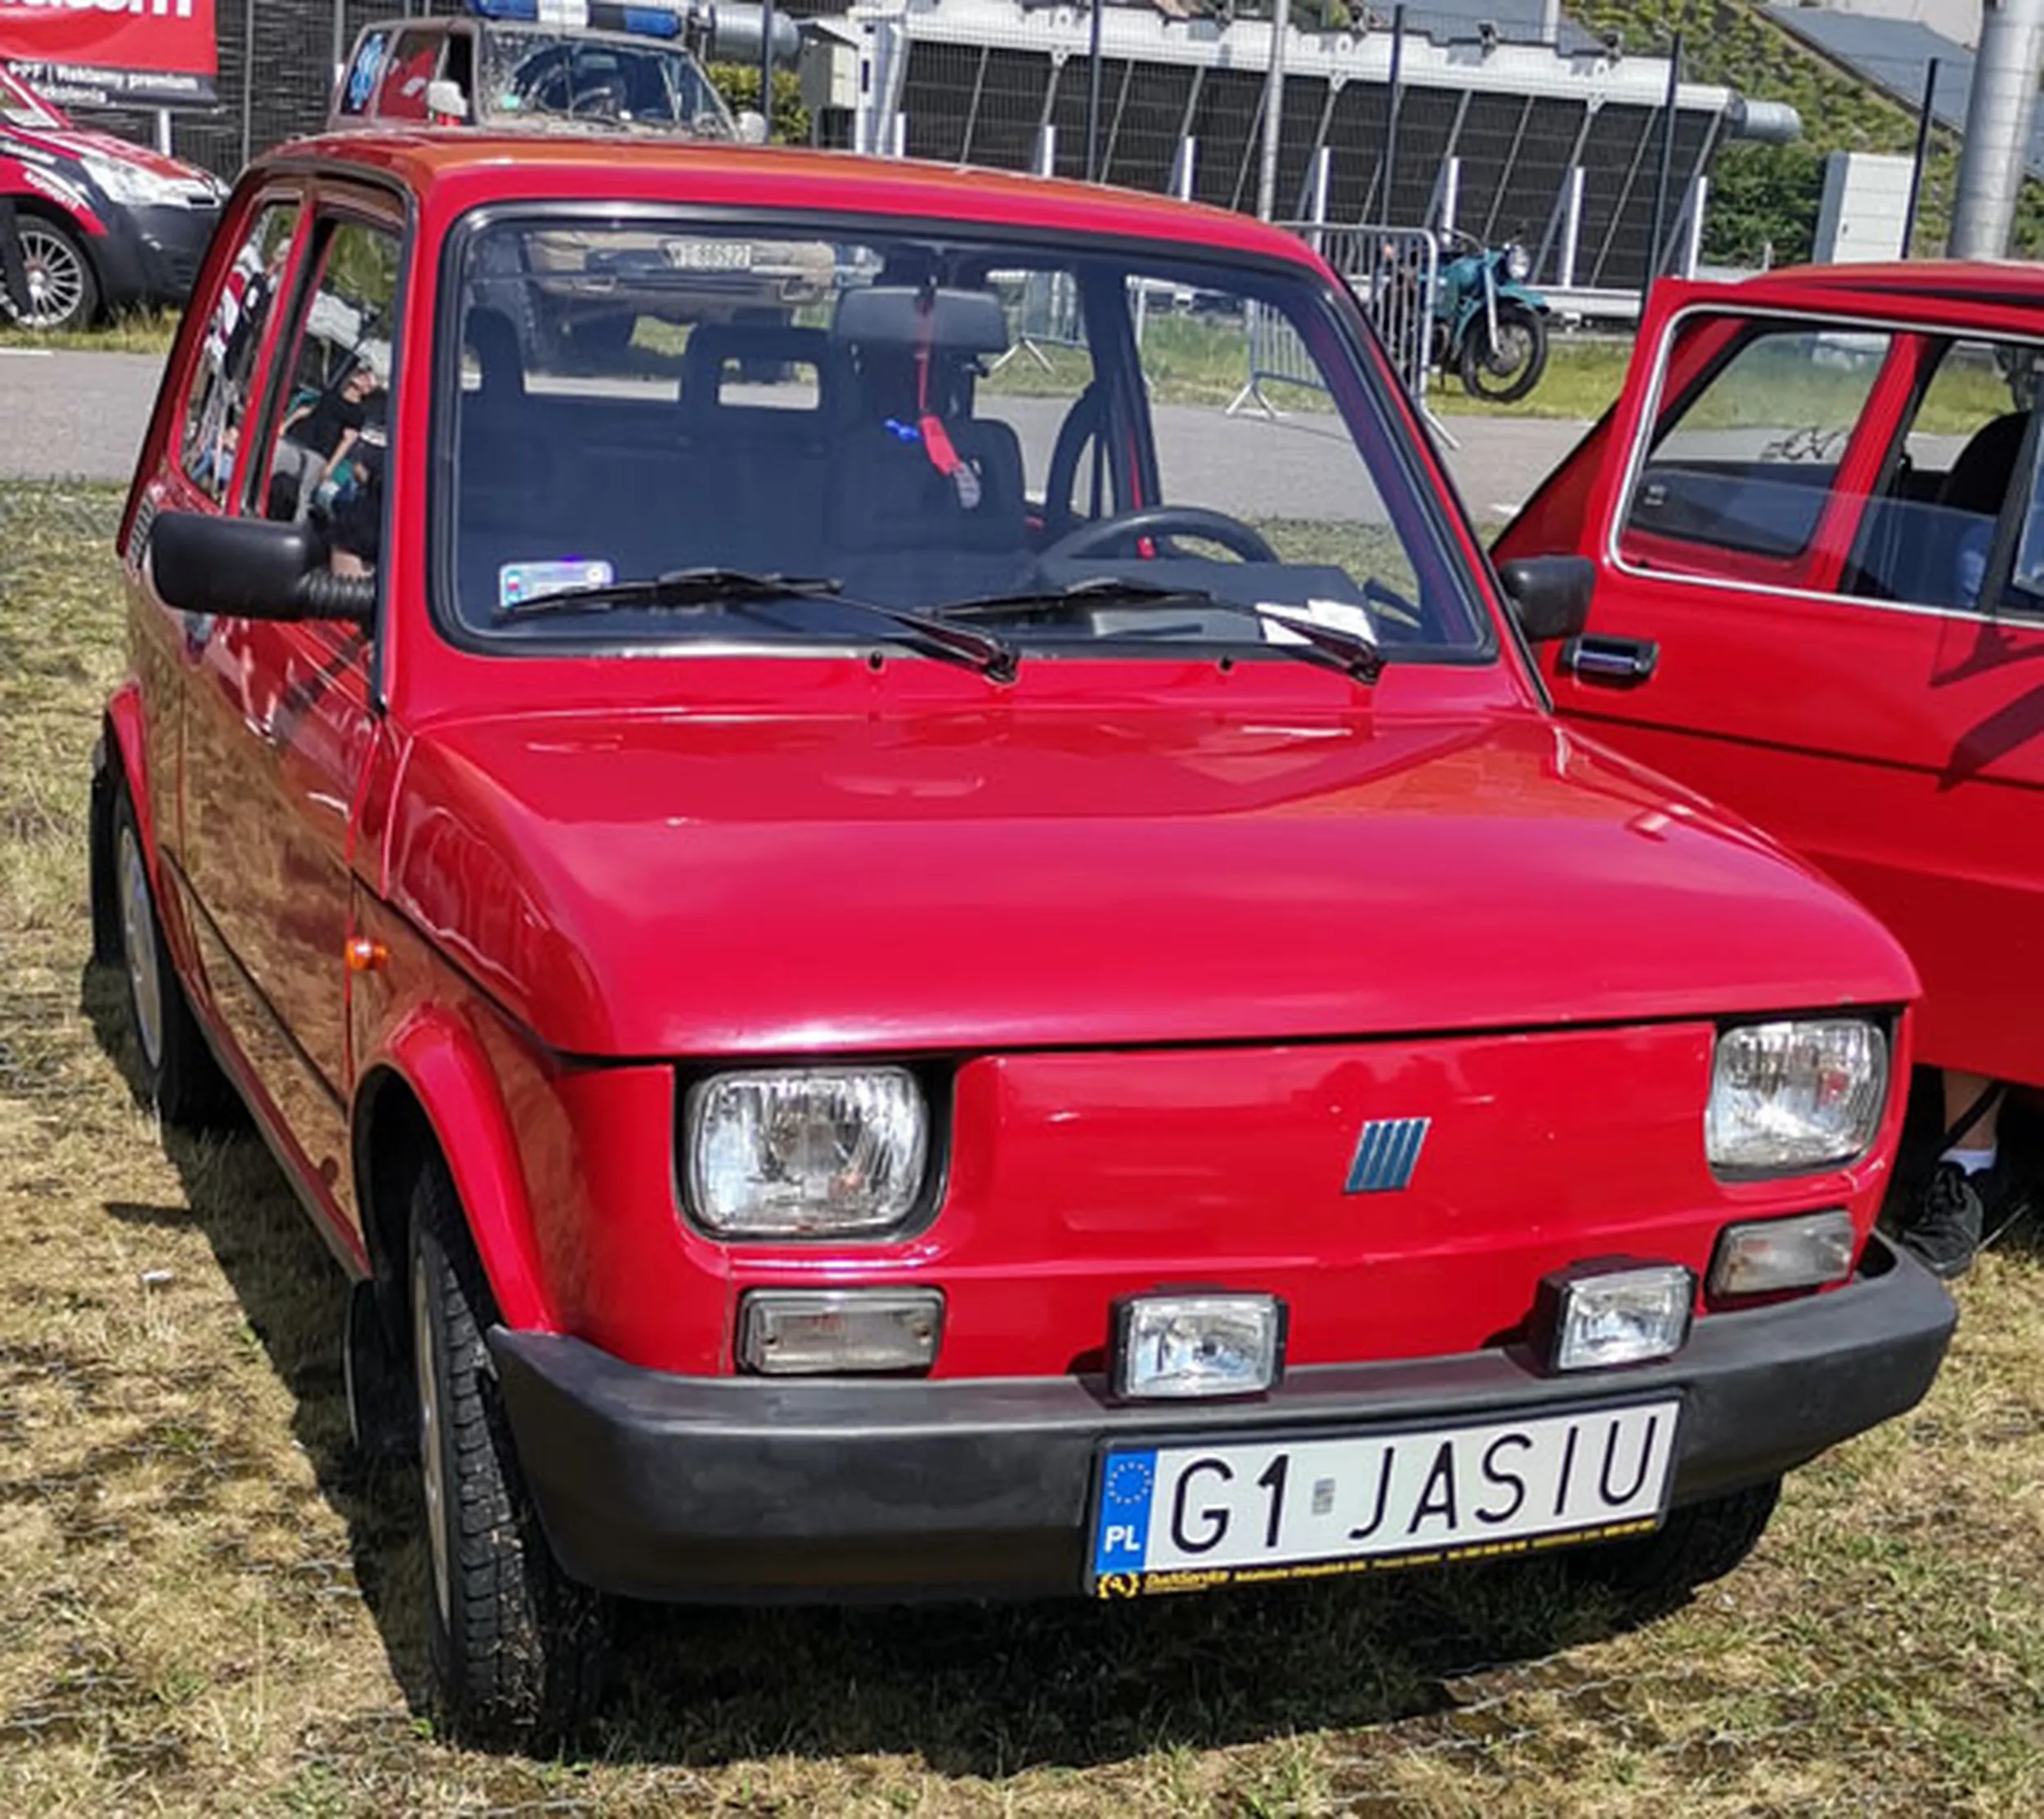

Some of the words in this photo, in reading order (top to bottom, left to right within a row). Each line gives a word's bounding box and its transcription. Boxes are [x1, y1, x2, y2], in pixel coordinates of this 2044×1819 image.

[1170, 1453, 1291, 1553] G1
[1348, 1415, 1658, 1540] JASIU
[1104, 1525, 1141, 1552] PL
